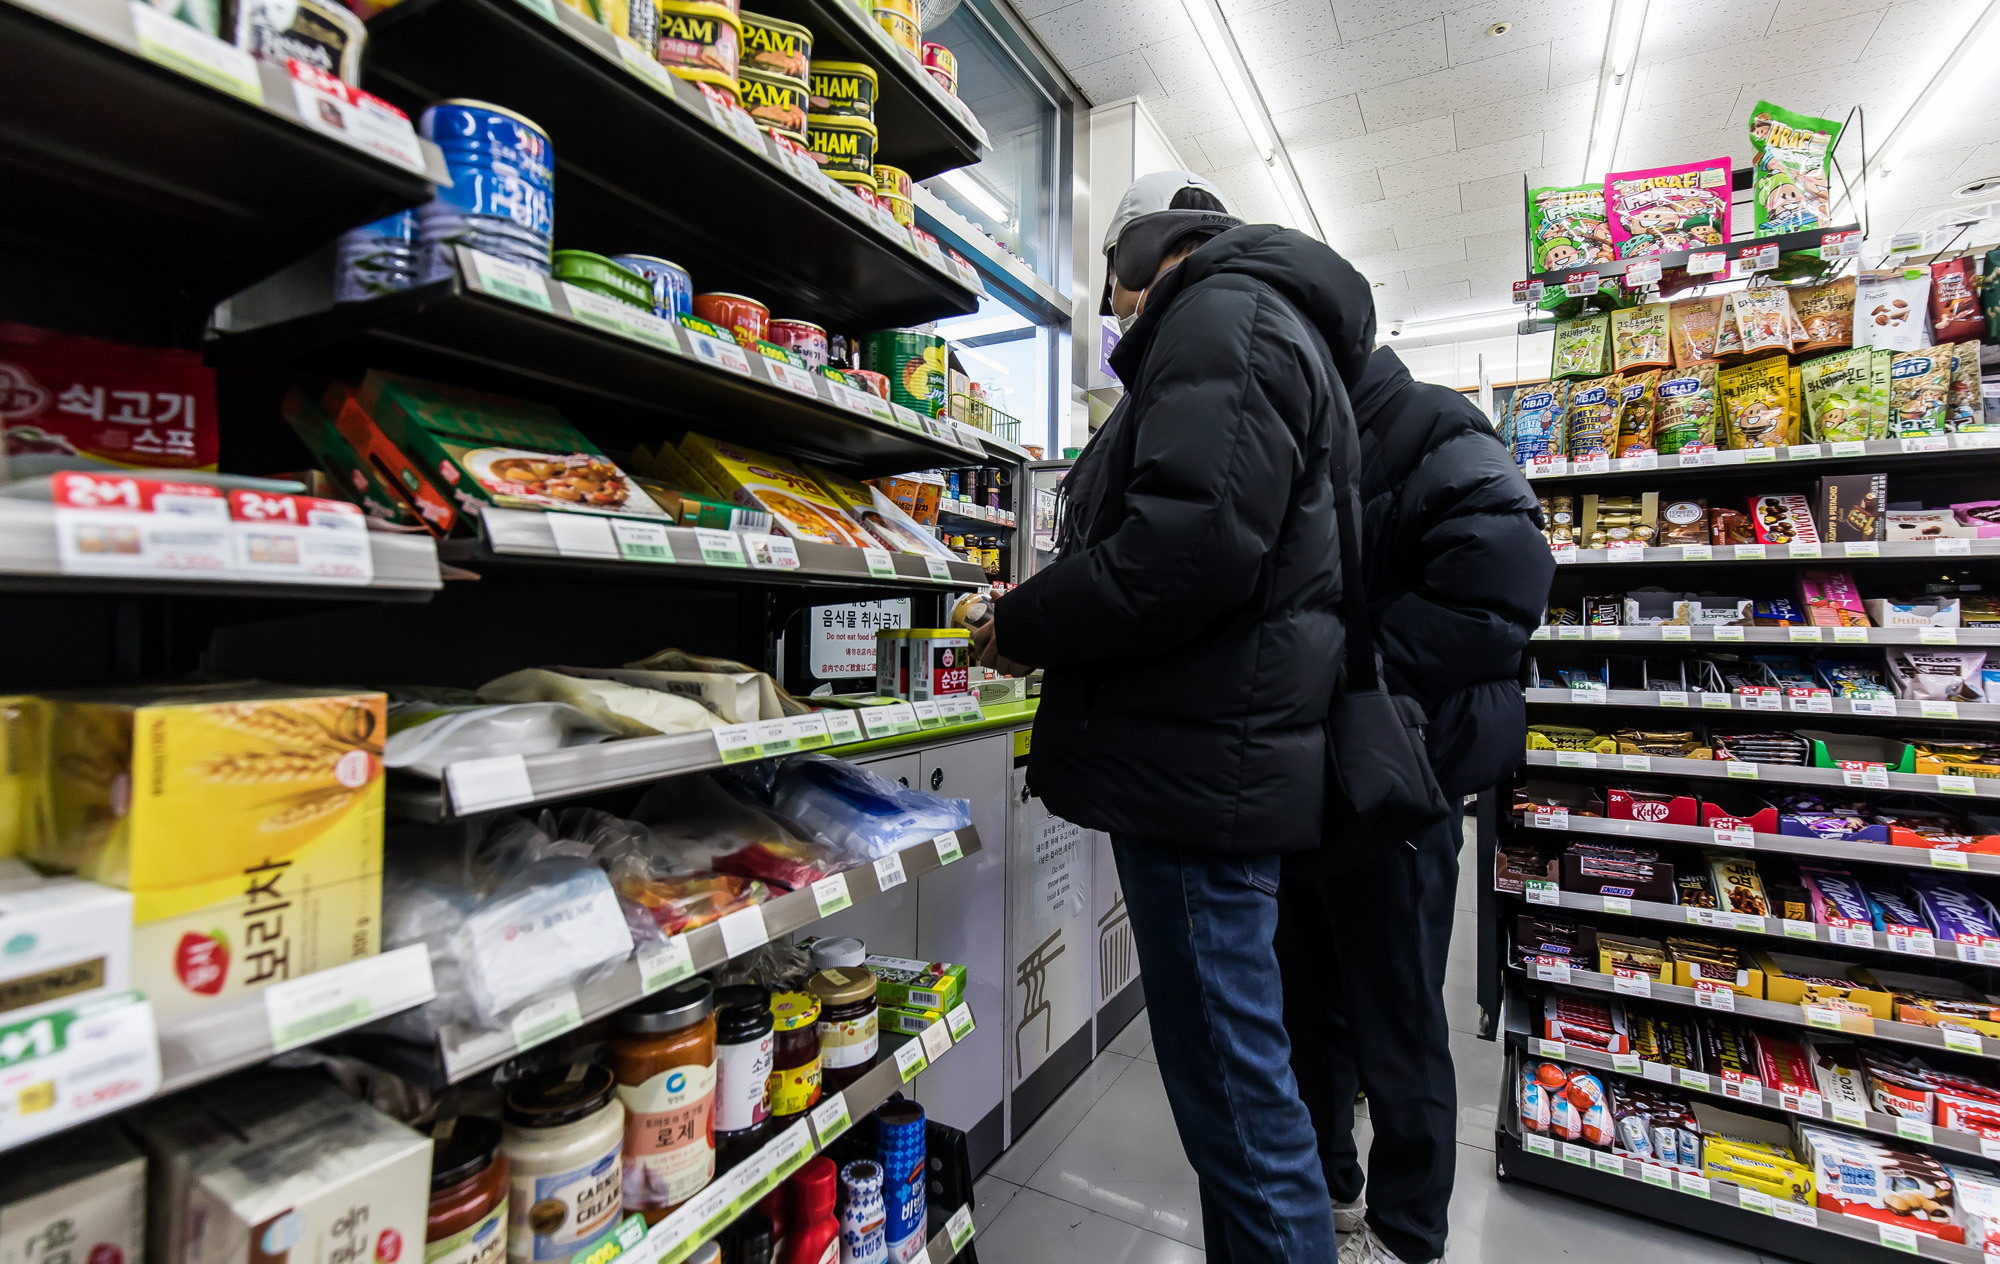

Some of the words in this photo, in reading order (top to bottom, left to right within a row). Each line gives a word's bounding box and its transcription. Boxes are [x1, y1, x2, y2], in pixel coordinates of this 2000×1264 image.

[659, 15, 713, 43] PAM
[741, 23, 796, 58] PAM
[738, 79, 792, 111] PAM
[1767, 122, 1813, 150] HBAF
[1640, 171, 1698, 192] HBAF
[1559, 190, 1605, 205] HBA
[1622, 188, 1714, 212] FRIENDS
[1547, 202, 1606, 222] FRIEN
[1575, 390, 1606, 404] HBAF
[1661, 382, 1696, 396] HBAF
[58, 382, 196, 430] 쇠고기
[1522, 398, 1551, 409] HBAF
[64, 474, 140, 507] 2+1
[240, 494, 298, 522] 2+1
[1787, 495, 1812, 544] MACADAMIA
[822, 609, 857, 629] 음식물
[861, 611, 902, 630] 취식금지
[826, 632, 835, 640] Do
[847, 633, 856, 641] eat
[857, 632, 870, 641] food
[942, 670, 967, 689] 순후추
[1637, 804, 1668, 821] KitKat
[1051, 866, 1058, 874] Do
[1528, 882, 1542, 890] 1+1
[1601, 886, 1634, 896] SNICKERS
[1818, 876, 1866, 920] Milka
[244, 858, 292, 986] 보리차
[1788, 910, 1803, 920] 72
[1541, 943, 1571, 955] SNICKERS
[1840, 1077, 1857, 1103] ZERO
[1878, 1091, 1925, 1114] nutella
[655, 1119, 695, 1149] 로제
[1707, 1160, 1733, 1173] Nesquik
